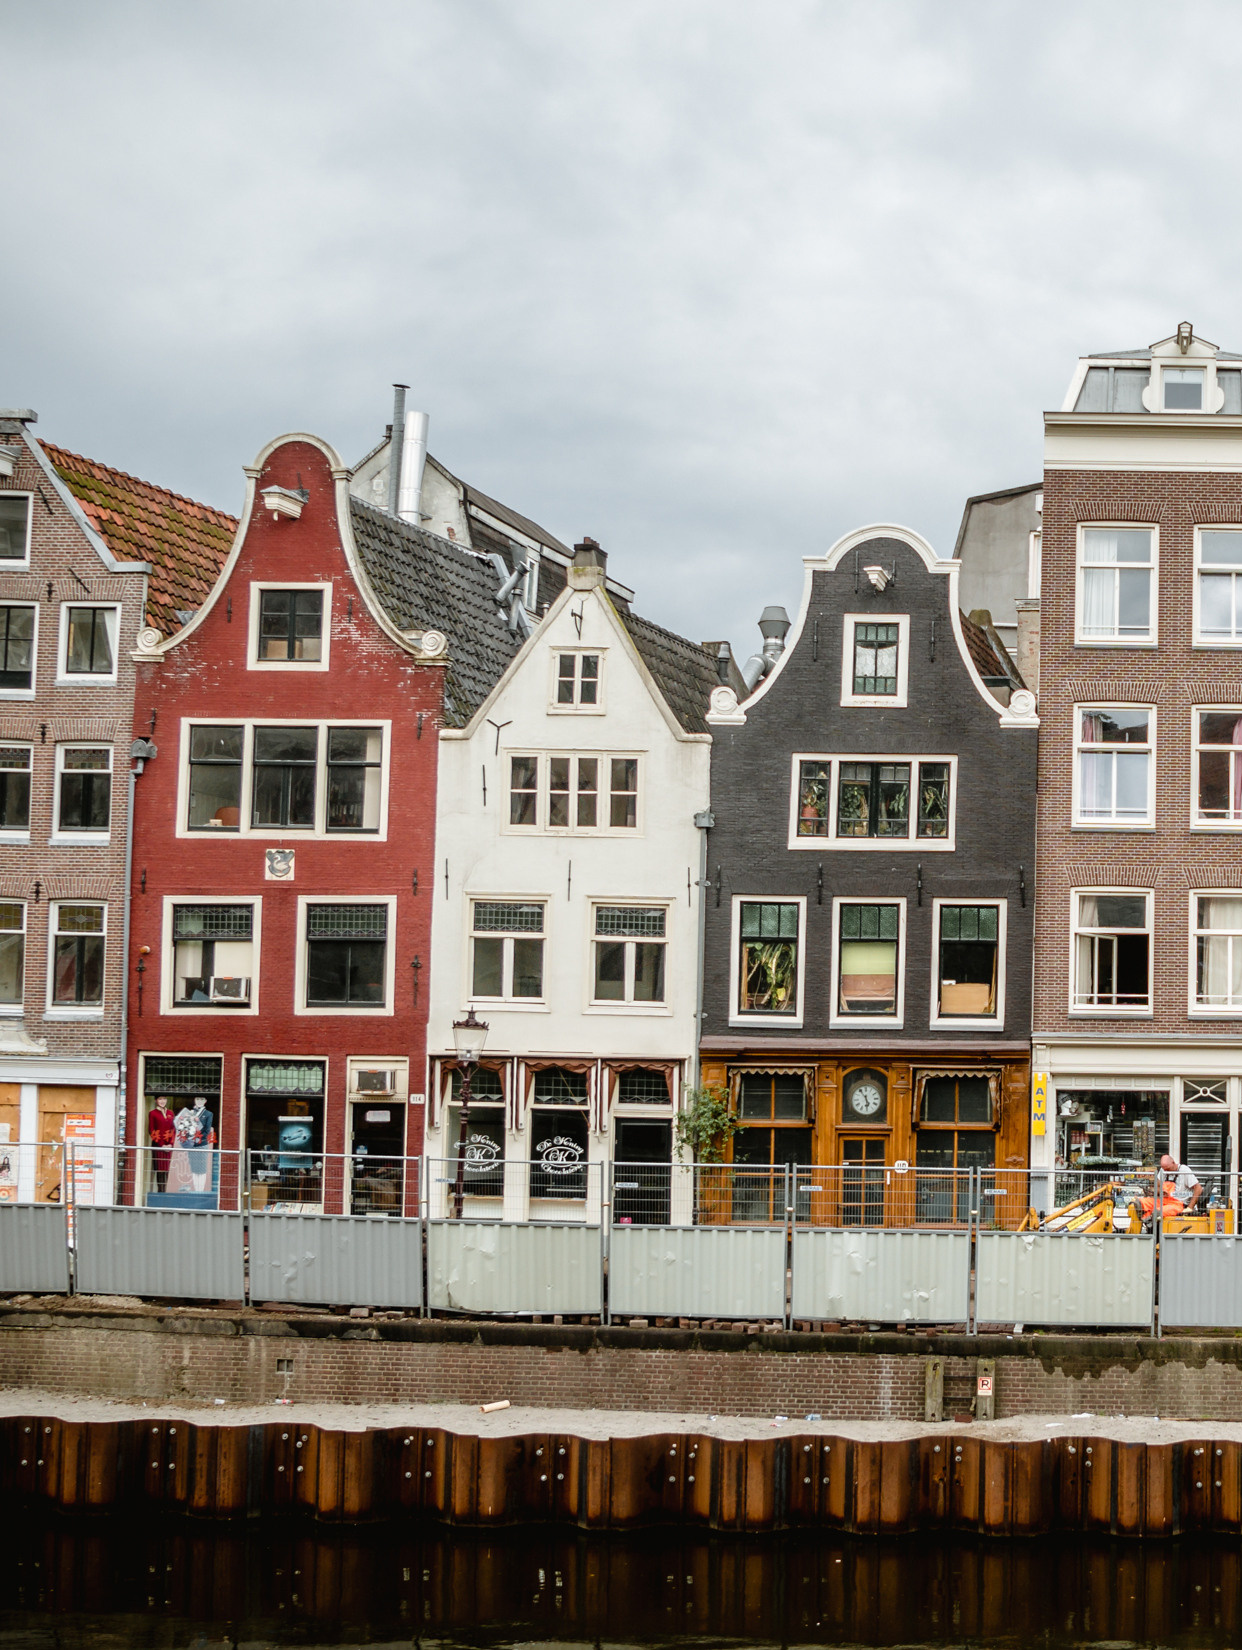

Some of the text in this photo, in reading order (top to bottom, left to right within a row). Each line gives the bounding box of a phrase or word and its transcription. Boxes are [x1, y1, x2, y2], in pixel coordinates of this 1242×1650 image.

[1033, 1087, 1045, 1121] ATM
[471, 1133, 501, 1152] Koning
[536, 1135, 584, 1155] De Koning
